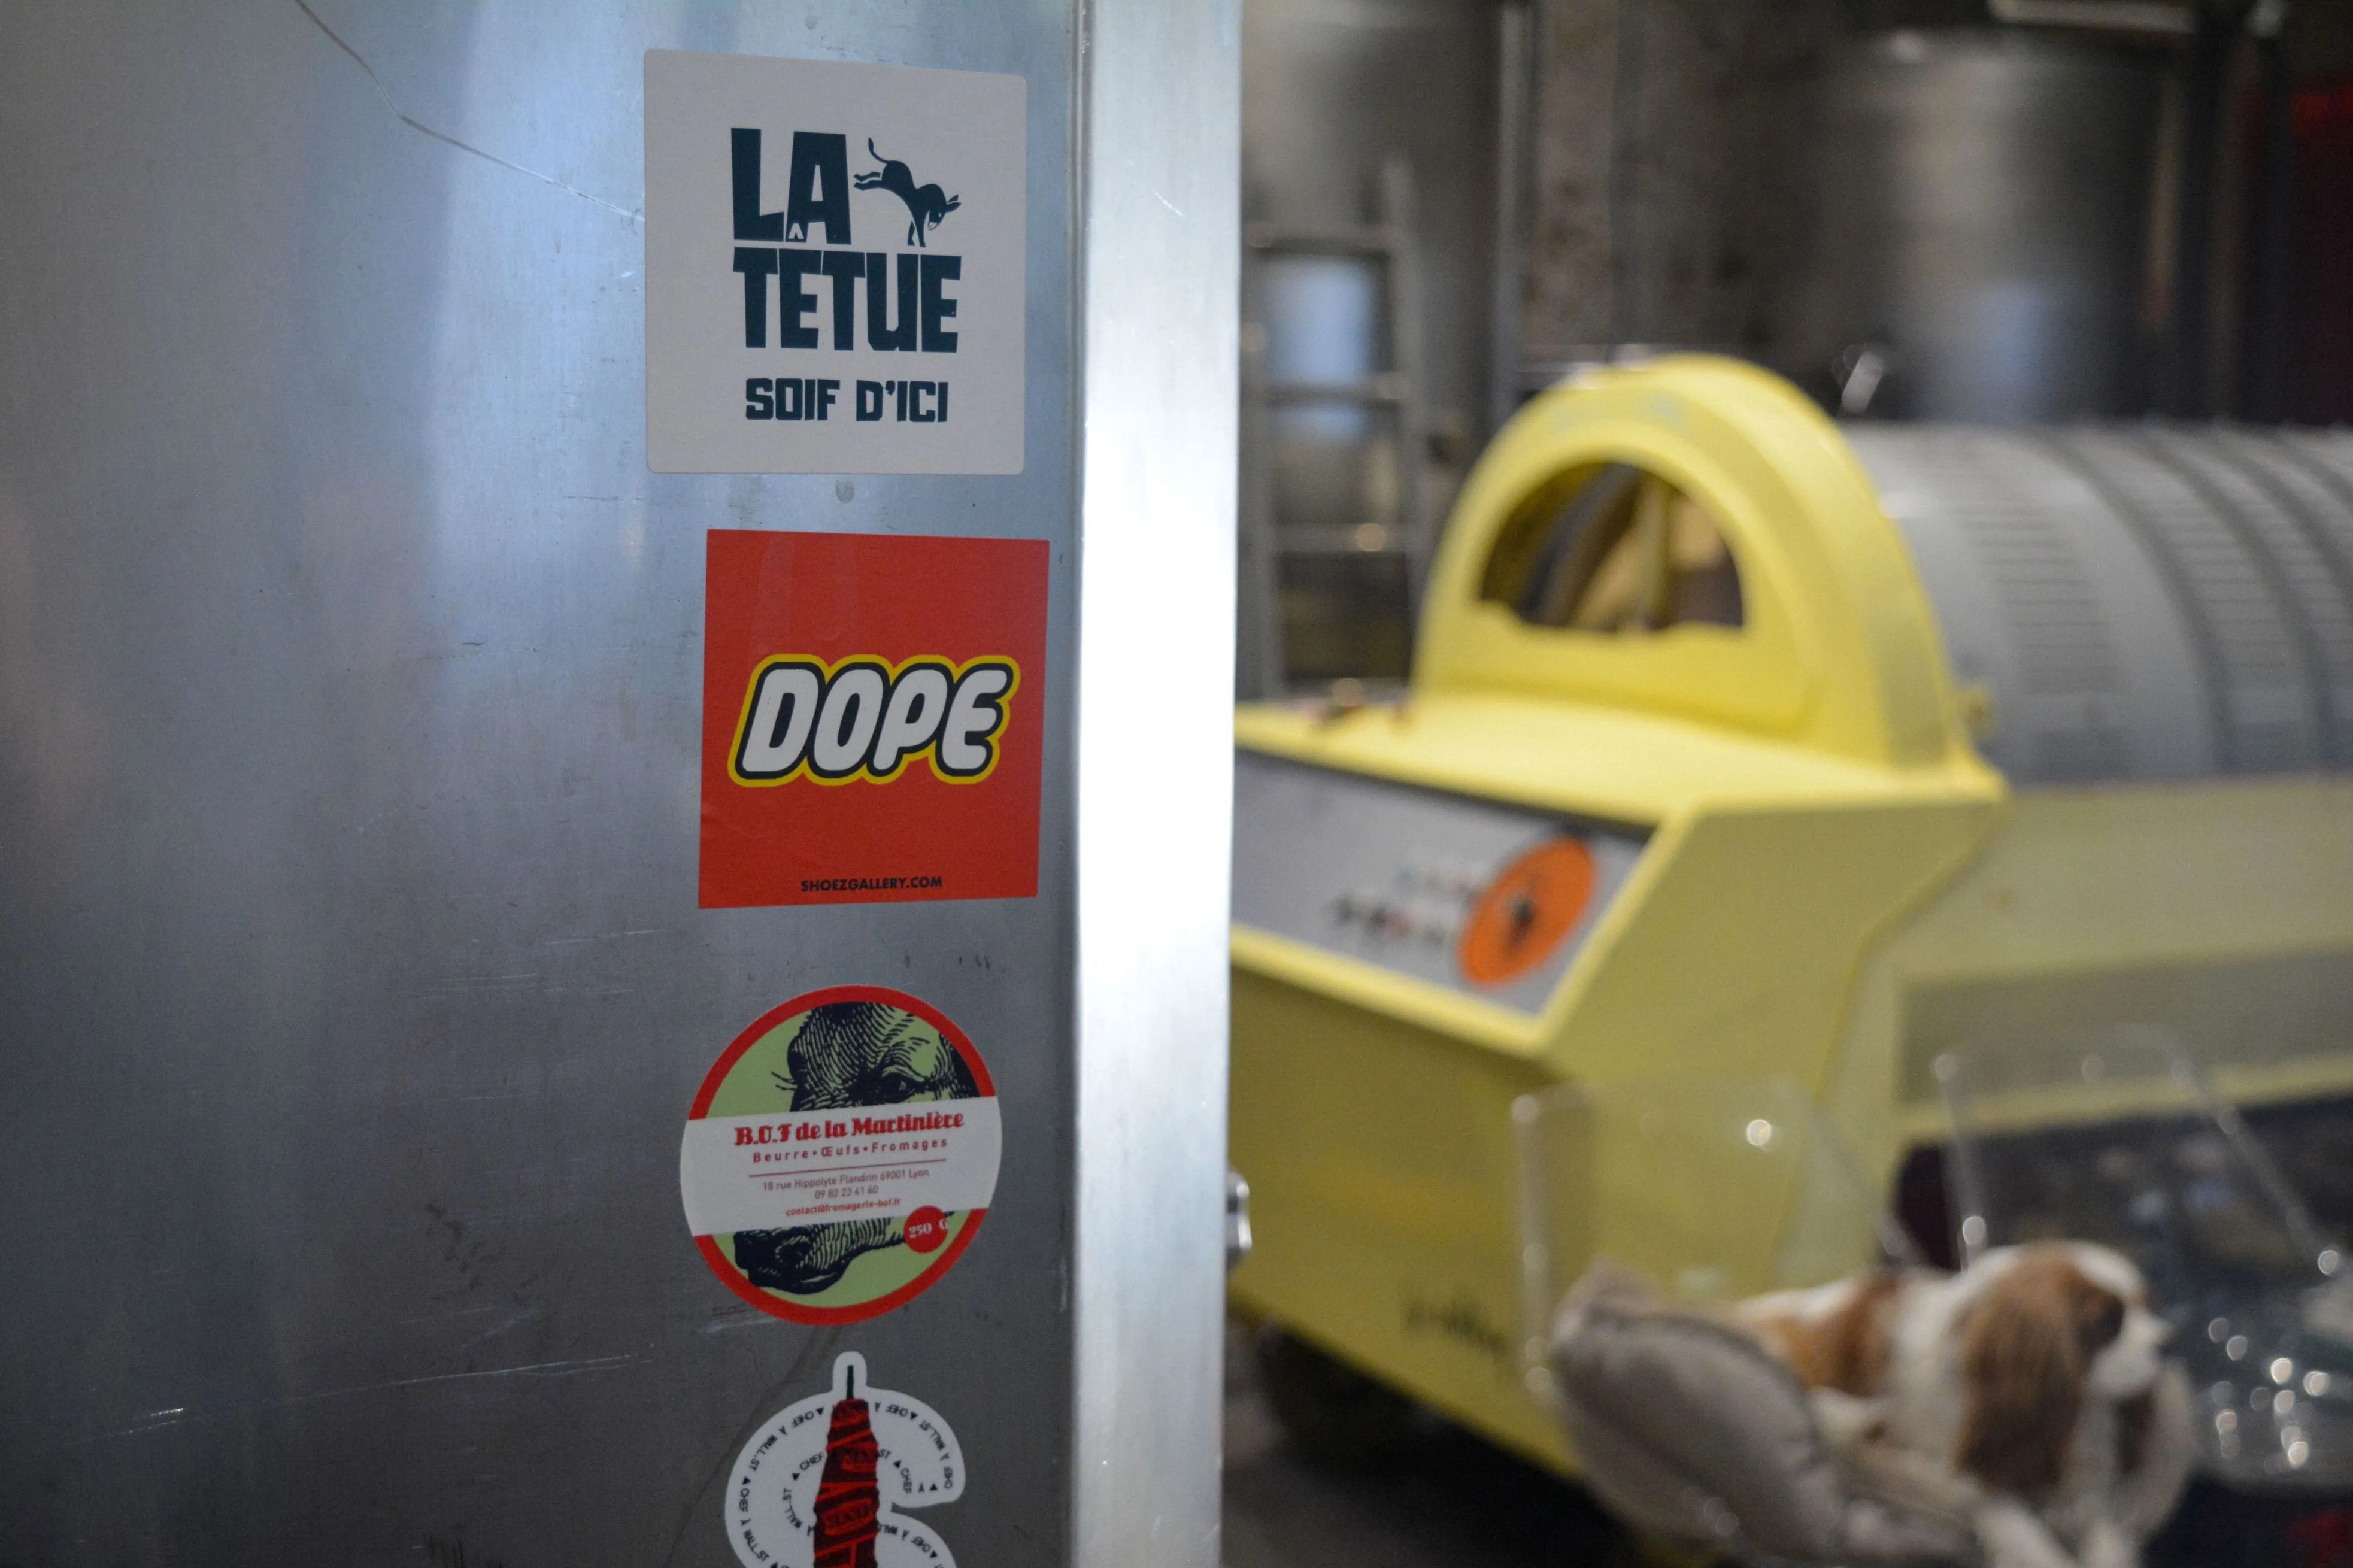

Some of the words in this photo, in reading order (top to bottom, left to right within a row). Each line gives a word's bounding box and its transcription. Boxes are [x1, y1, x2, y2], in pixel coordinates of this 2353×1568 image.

[731, 128, 851, 245] LA
[746, 378, 841, 421] SOIF
[856, 380, 948, 423] D'ICI
[735, 662, 1014, 780] DOPE
[801, 876, 942, 892] SHOEZGALLERY.COM
[795, 1122, 821, 1141] de
[824, 1120, 848, 1138] la
[851, 1111, 963, 1136] Martinière
[763, 1181, 774, 1191] 18
[795, 1175, 837, 1189] Hippolyte
[839, 1173, 878, 1184] Flandrin
[880, 1169, 906, 1180] 69001
[909, 1169, 930, 1179] Lyon
[814, 1189, 826, 1199] 09
[828, 1188, 839, 1197] 82
[841, 1187, 852, 1197] 23
[868, 1185, 879, 1194] 60
[909, 1223, 932, 1239] 250
